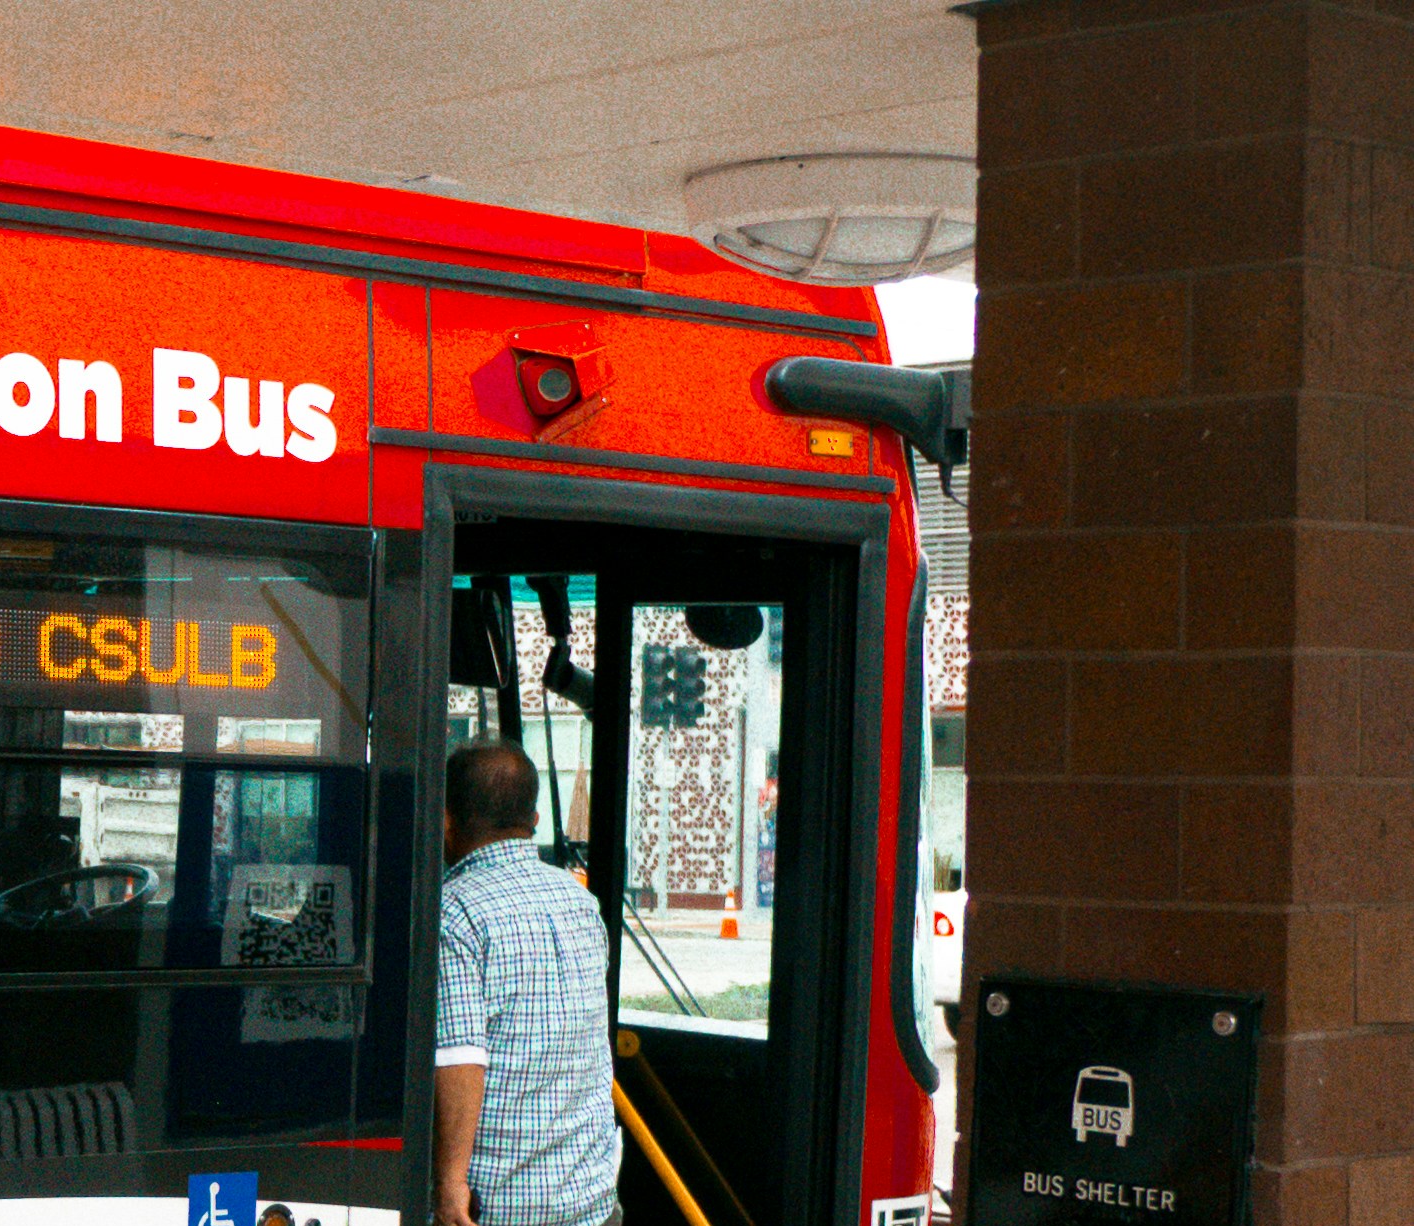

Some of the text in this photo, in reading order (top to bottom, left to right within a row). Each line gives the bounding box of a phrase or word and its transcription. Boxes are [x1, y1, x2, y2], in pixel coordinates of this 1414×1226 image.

[153, 347, 338, 463] Bus
[38, 614, 278, 689] CSULB
[1083, 1108, 1121, 1130] BUS
[1023, 1172, 1175, 1212] BUS SHELTER
